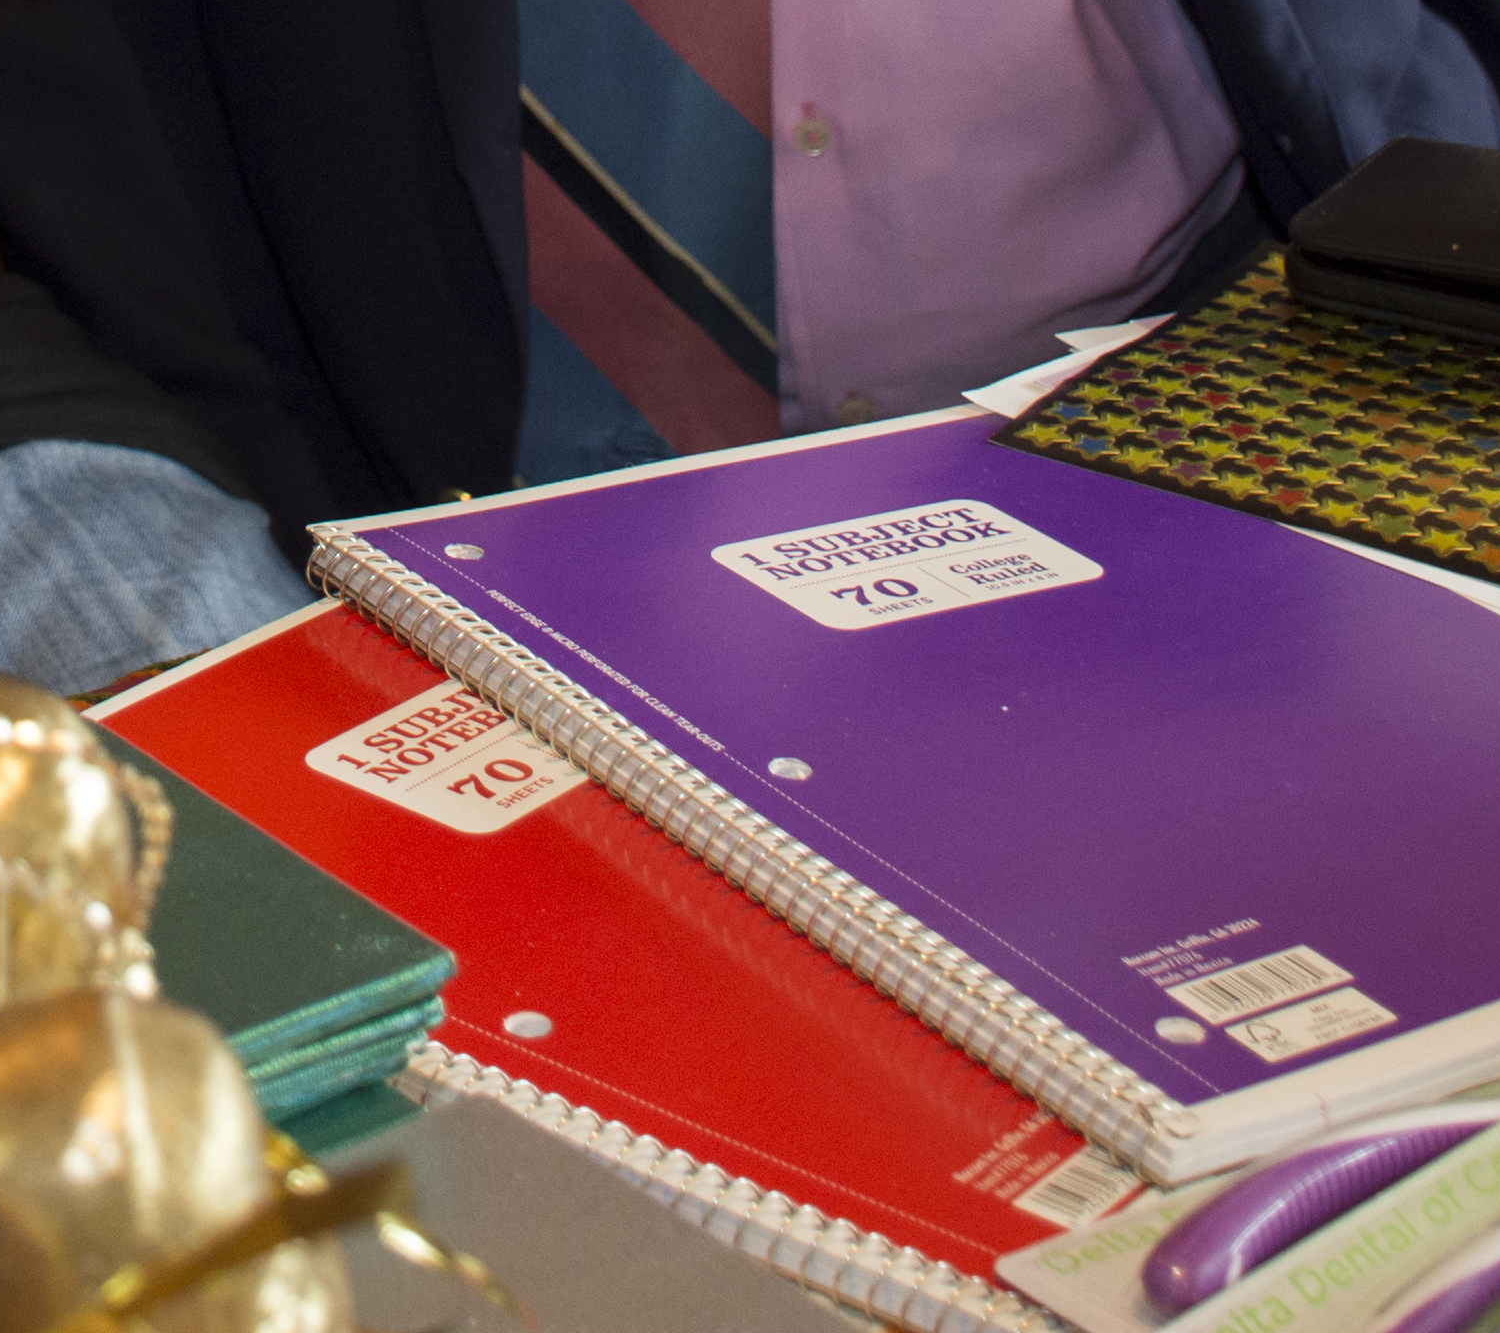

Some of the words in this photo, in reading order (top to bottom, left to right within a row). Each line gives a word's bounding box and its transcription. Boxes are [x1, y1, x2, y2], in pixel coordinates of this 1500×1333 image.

[740, 552, 771, 568] 1
[772, 507, 983, 561] SUBJECT
[759, 521, 1013, 582] NOTEBOOK
[948, 553, 1033, 575] College
[964, 561, 1050, 585] Ruled
[828, 578, 920, 608] 70
[868, 596, 934, 617] SHEETS
[627, 683, 651, 701] FOR
[645, 696, 679, 721] CLEAN
[337, 753, 371, 770] 1
[362, 688, 484, 755] SUBJ
[364, 709, 508, 784] NOTEB
[446, 758, 534, 800] 70
[496, 776, 555, 809] SHEETS
[1039, 1208, 1165, 1278] Delta
[1289, 1234, 1417, 1307] Dental
[1420, 1184, 1465, 1227] of
[1212, 1284, 1300, 1333] elta
